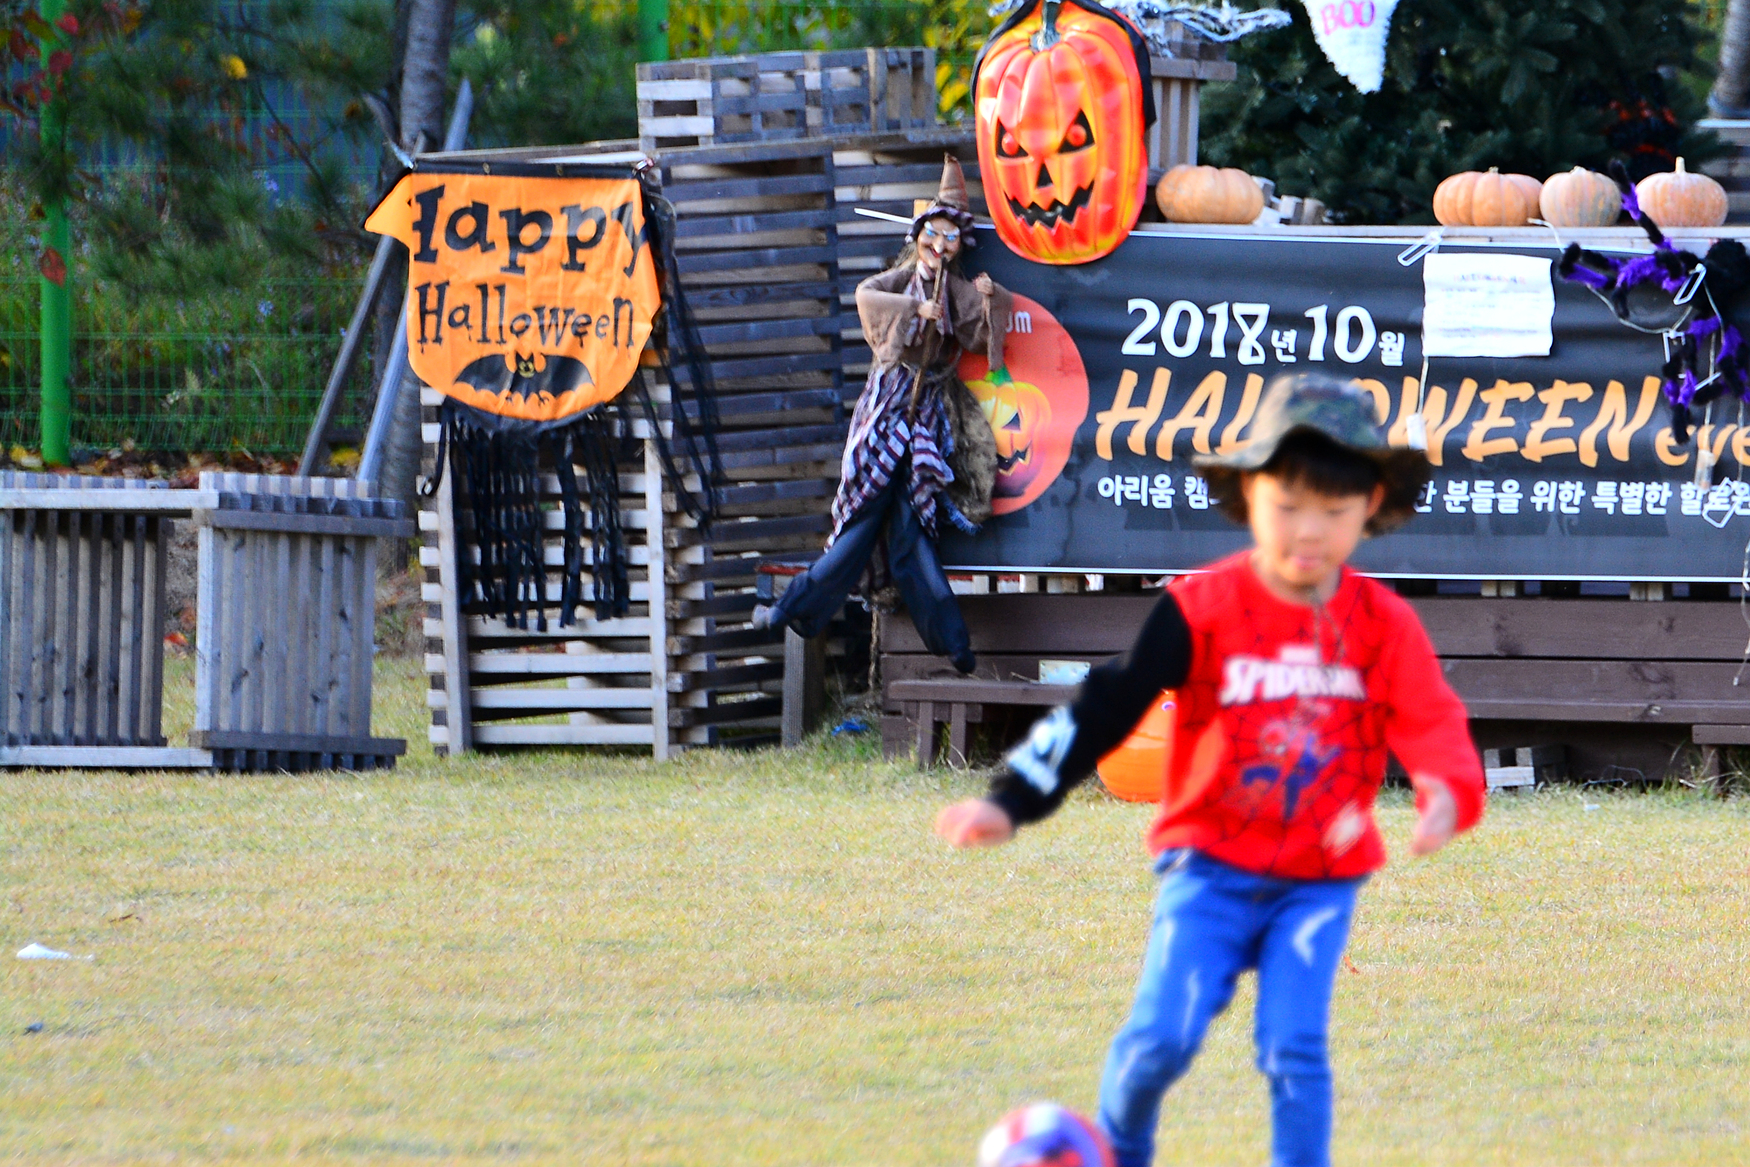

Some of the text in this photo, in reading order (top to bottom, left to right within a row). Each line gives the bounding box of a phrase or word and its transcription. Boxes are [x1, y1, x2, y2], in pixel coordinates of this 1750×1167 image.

[1321, 0, 1376, 35] BOO
[1304, 304, 1406, 367] 10월
[1097, 474, 1176, 510] 아리움
[1443, 479, 1524, 515] 분들을
[1530, 480, 1587, 515] 위한
[1591, 480, 1673, 516] 특별한
